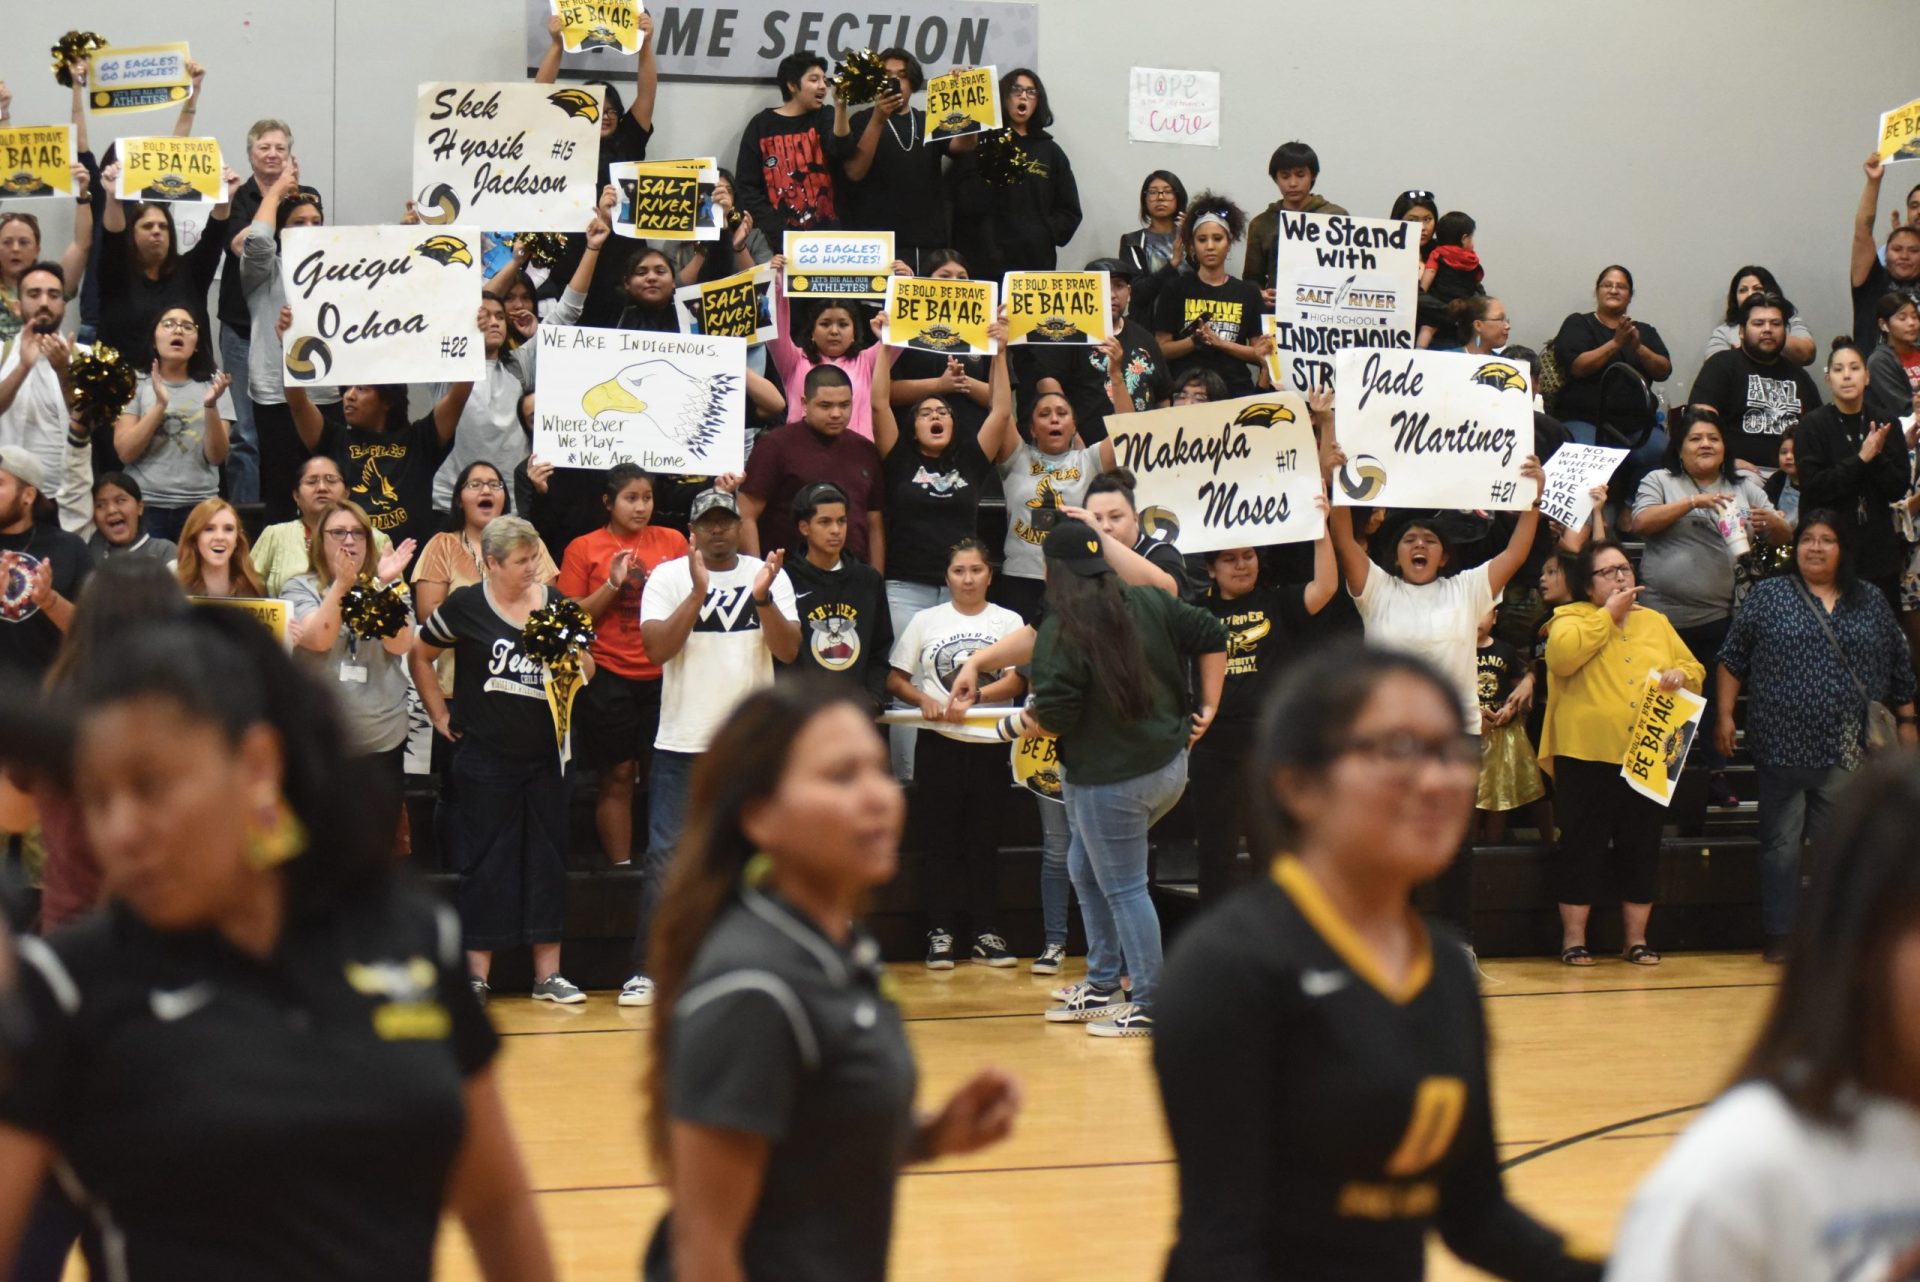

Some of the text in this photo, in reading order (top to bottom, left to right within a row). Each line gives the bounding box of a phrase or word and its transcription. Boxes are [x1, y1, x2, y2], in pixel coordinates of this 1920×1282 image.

[563, 7, 584, 27] BE
[757, 10, 990, 66] SECTION
[101, 61, 119, 71] GO
[101, 71, 118, 81] GO
[113, 95, 168, 106] ATHLETES!
[430, 88, 502, 121] Skek
[929, 86, 989, 114] E BA'AG.
[1884, 120, 1901, 141] BE
[6, 144, 66, 169] BA'AG.
[550, 138, 576, 161] #15
[129, 152, 216, 176] BE BA'AG.
[471, 162, 568, 206] Jackson
[639, 178, 696, 196] SALT
[639, 197, 694, 214] RIVER
[638, 213, 691, 229] PRIDE
[1281, 212, 1409, 250] We Stand
[799, 255, 881, 265] GO HUSKIES!
[800, 244, 881, 254] GO EAGLES!
[293, 250, 413, 299] Guigu
[1012, 279, 1024, 290] BE
[1051, 278, 1063, 290] BE
[705, 285, 752, 311] SALT
[811, 283, 869, 292] ATHLETES!
[898, 283, 909, 296] BE
[940, 286, 953, 298] BE
[1295, 287, 1396, 309] SALT RIVER
[896, 296, 986, 326] BE BA'AG.
[1011, 291, 1099, 315] BE BA'AG.
[1184, 298, 1243, 315] NATIVE
[317, 301, 430, 344] Ochoa
[707, 305, 755, 327] RIVER
[1310, 313, 1377, 326] HIGH SCHOOL
[441, 336, 468, 358] #22
[542, 328, 567, 349] WE
[572, 328, 606, 350] ARE
[1276, 321, 1413, 356] INDIGENOUS
[1292, 357, 1336, 393] STR
[1358, 353, 1425, 411] Jade
[557, 434, 577, 448] We
[1114, 422, 1251, 475] Makayla
[1390, 410, 1518, 467] Martinez
[349, 443, 407, 459] EGLES
[609, 452, 634, 465] Are
[643, 452, 687, 468] Home
[1276, 448, 1297, 473] #17
[1558, 451, 1618, 464] MATTER
[1583, 447, 1604, 455] NO
[1558, 459, 1607, 471] WHERE
[1566, 467, 1587, 475] WE
[1490, 480, 1517, 503] #21
[1552, 480, 1579, 495] WE
[1198, 481, 1291, 529] Moses
[1543, 488, 1577, 510] ARE
[1539, 499, 1578, 528] OME!
[1020, 736, 1045, 759] BE
[1632, 694, 1675, 780] BE BA'AG.
